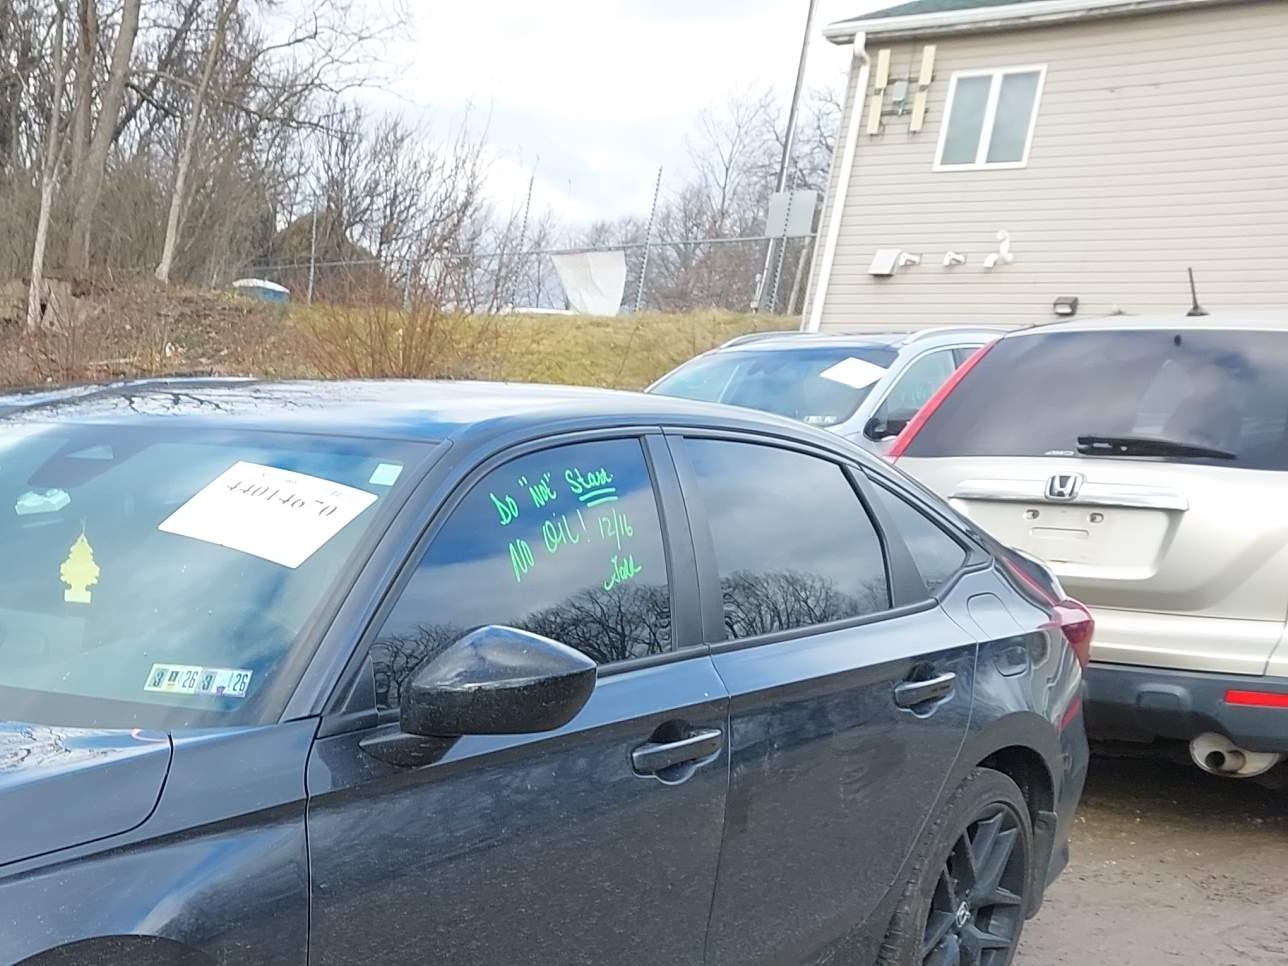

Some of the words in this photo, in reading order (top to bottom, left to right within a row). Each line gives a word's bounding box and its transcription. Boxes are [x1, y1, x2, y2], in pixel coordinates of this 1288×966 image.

[598, 508, 633, 551] 12/16
[181, 670, 198, 689] 26
[232, 672, 249, 692] 26
